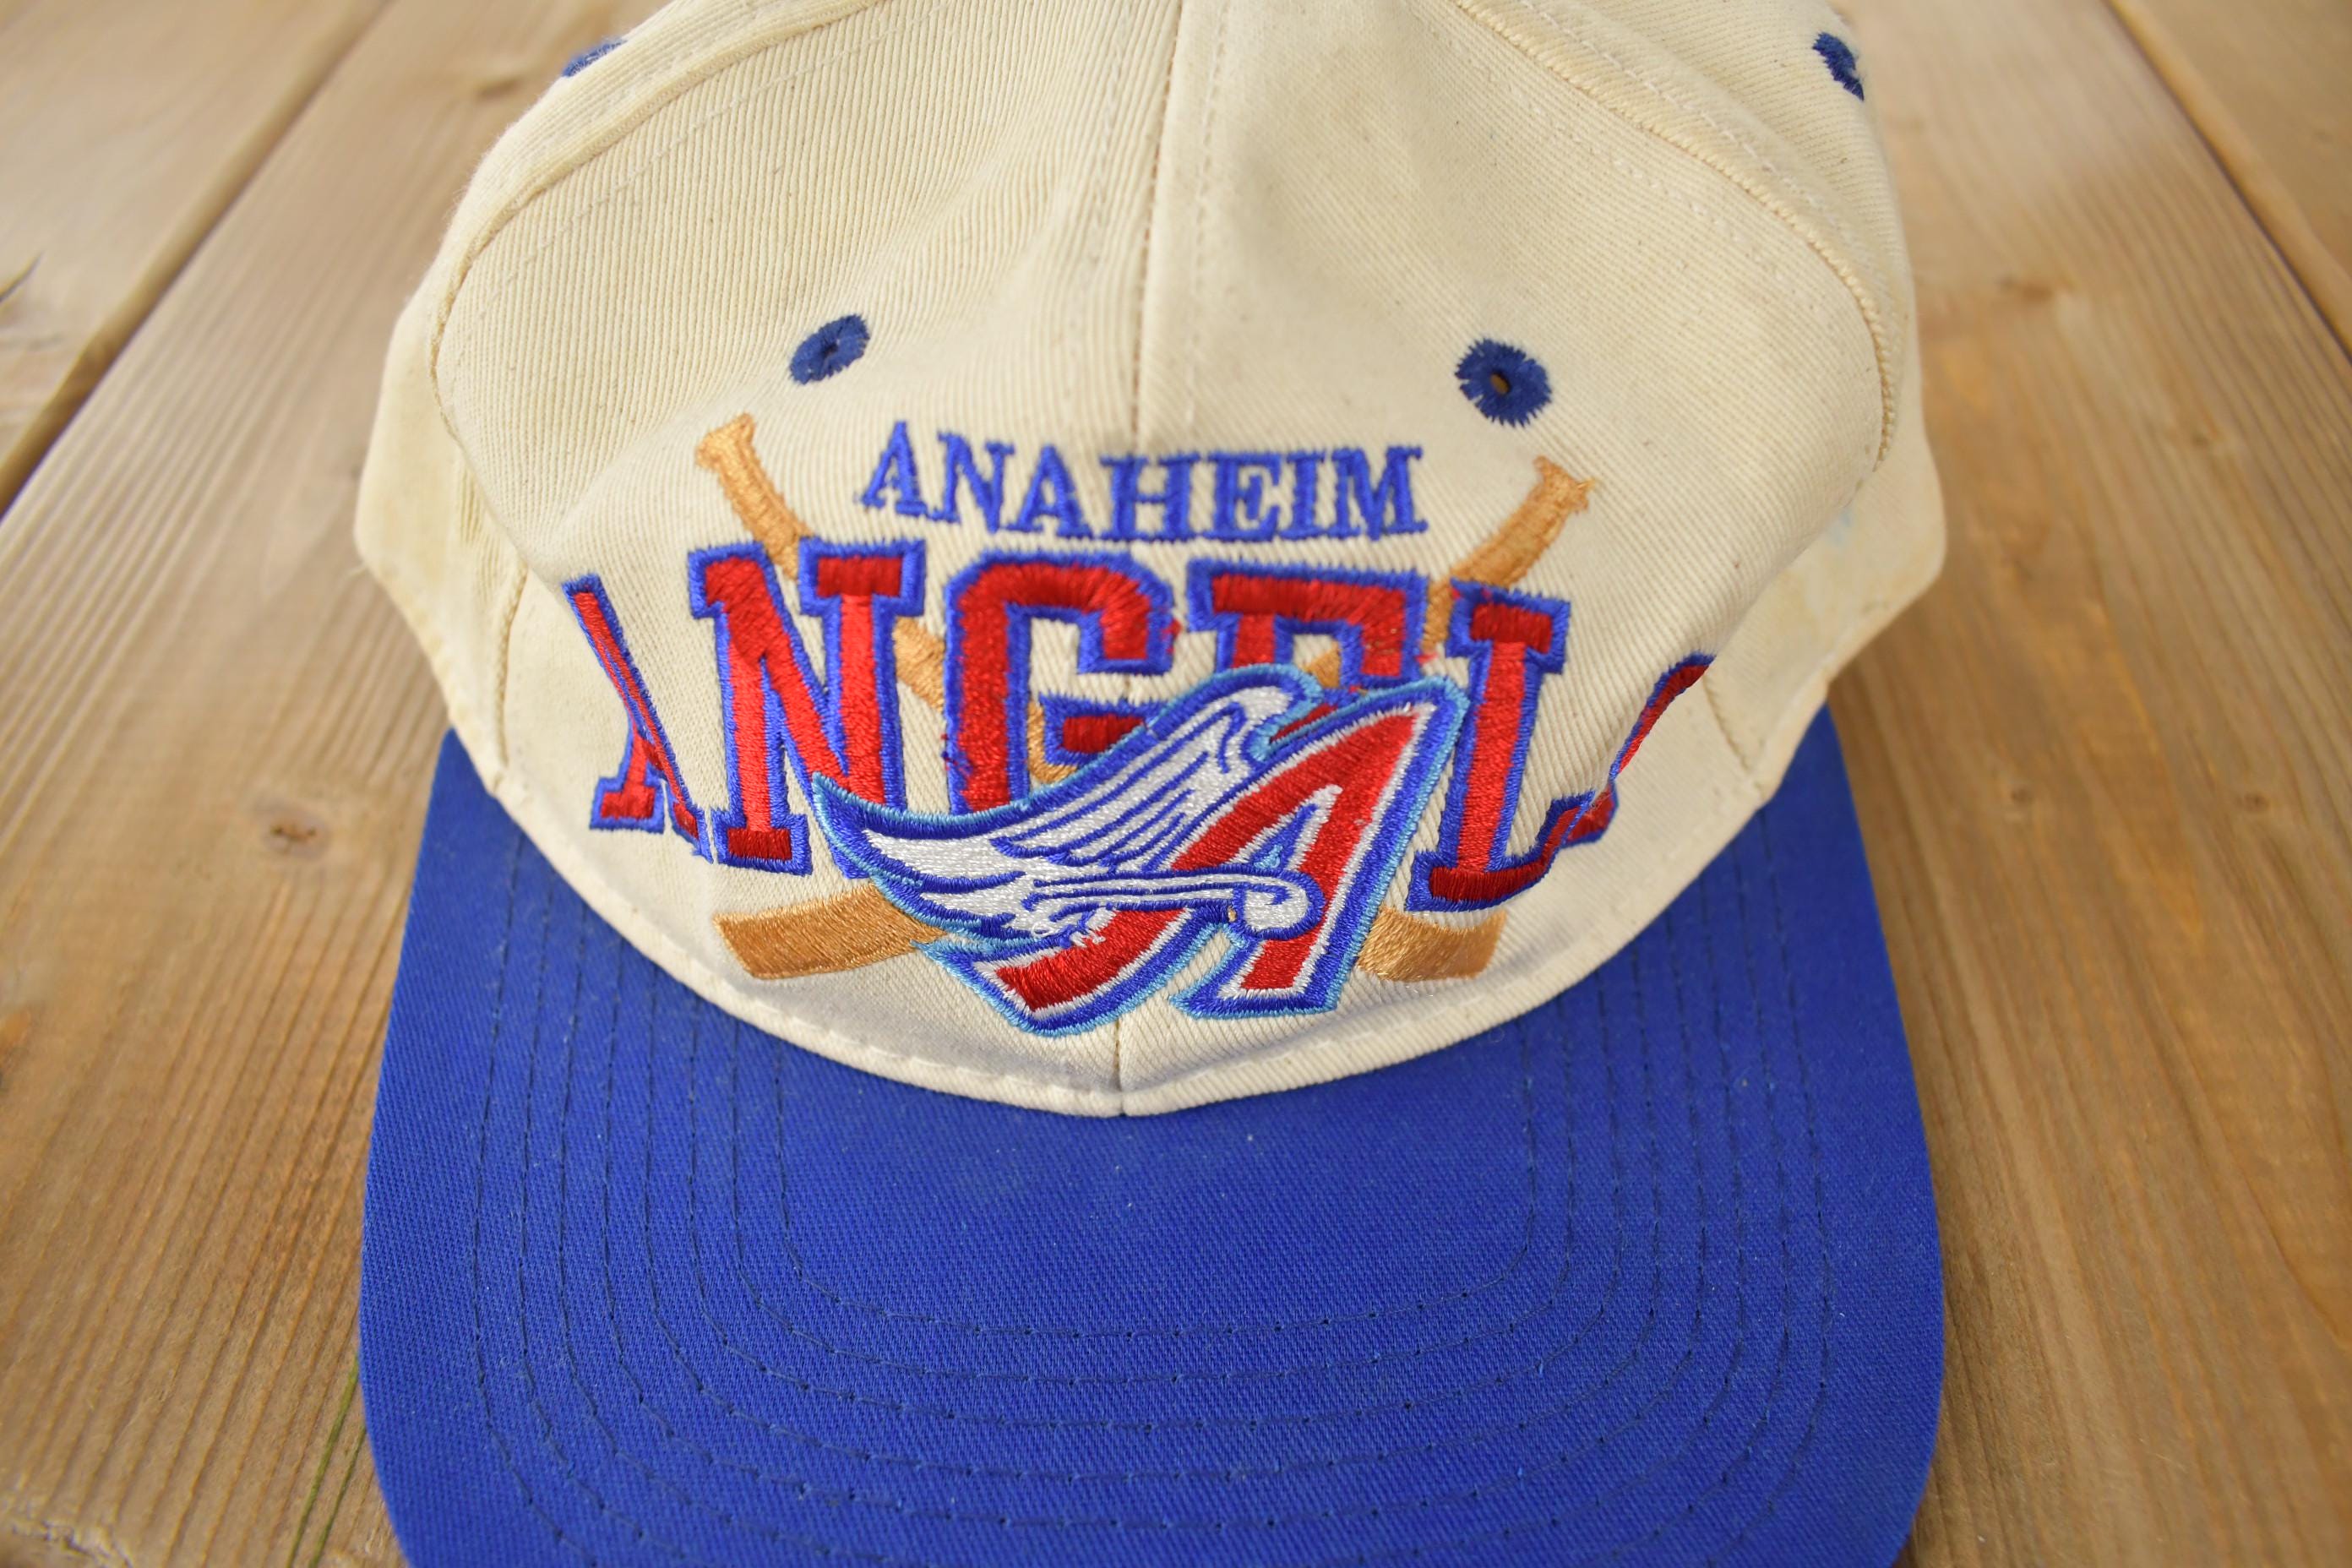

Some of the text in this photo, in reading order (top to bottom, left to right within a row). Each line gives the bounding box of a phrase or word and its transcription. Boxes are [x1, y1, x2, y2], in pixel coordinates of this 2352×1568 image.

[859, 420, 1429, 543] ANAHEIM
[562, 536, 1716, 911] ANGL
[919, 676, 1468, 1037] A
